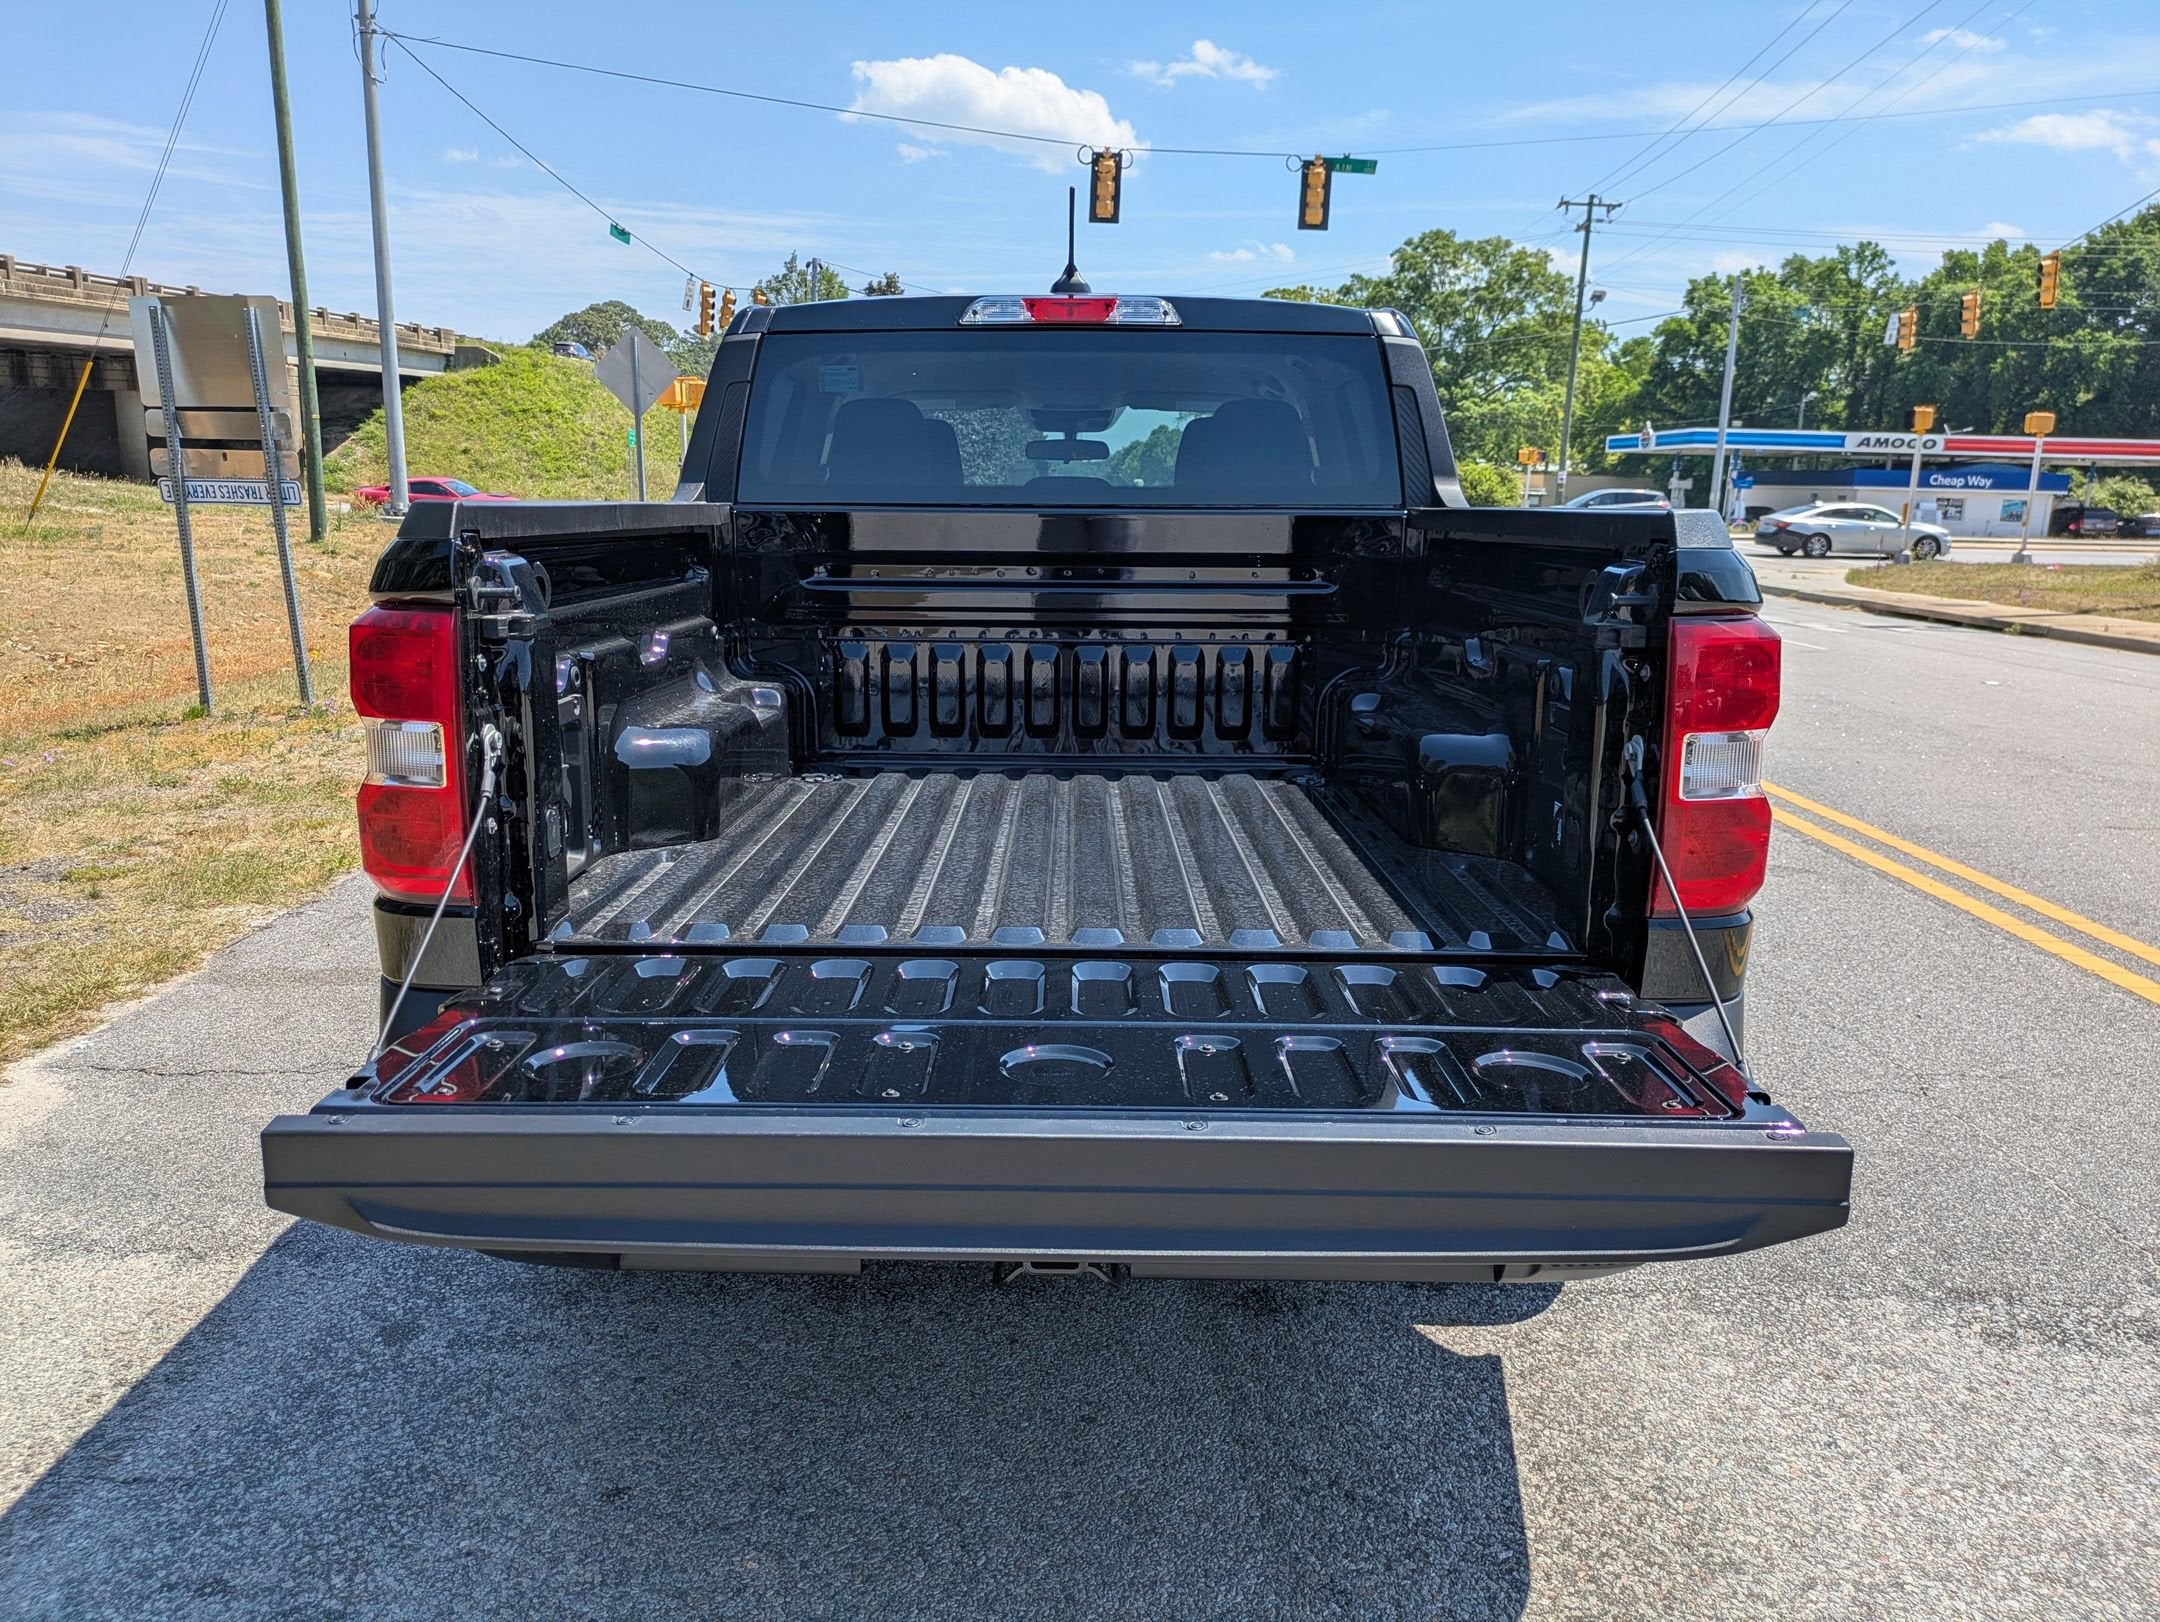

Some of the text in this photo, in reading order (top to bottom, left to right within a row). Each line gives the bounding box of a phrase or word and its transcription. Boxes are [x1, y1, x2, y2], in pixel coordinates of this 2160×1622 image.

[1857, 437, 1937, 449] AMOCO
[1929, 474, 1993, 488] Cheap Way
[164, 484, 297, 501] LITR TRASHES EVERYE
